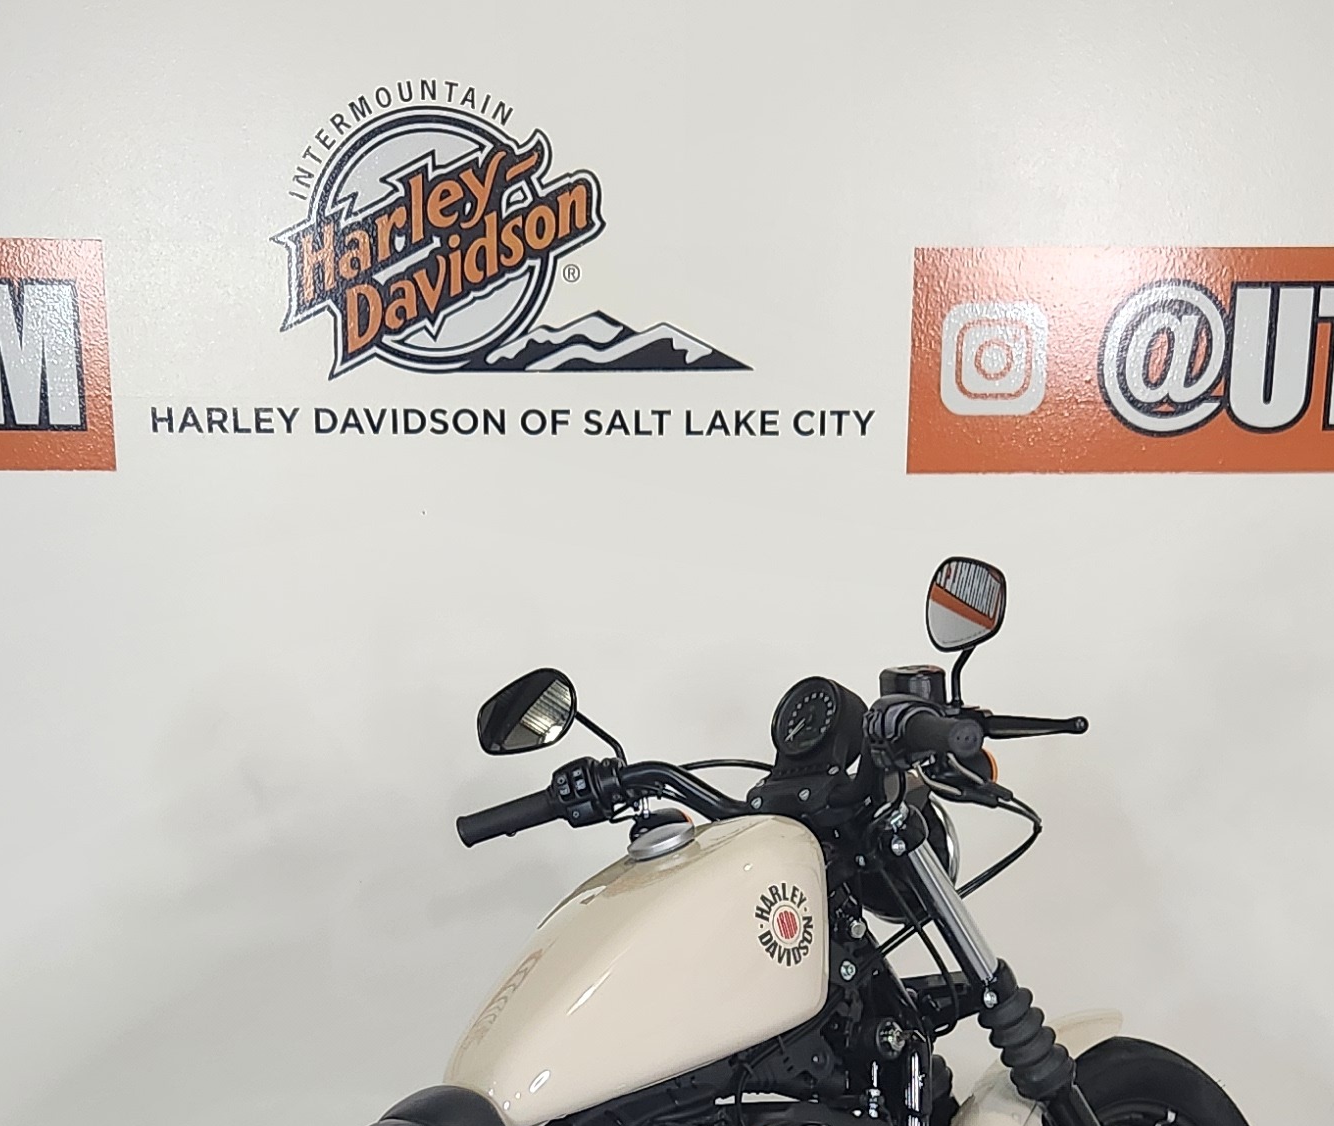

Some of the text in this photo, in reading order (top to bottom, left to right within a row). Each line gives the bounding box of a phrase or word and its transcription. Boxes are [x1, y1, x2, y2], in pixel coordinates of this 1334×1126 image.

[289, 79, 514, 200] INTERMOUNTAIN
[344, 183, 590, 355] Davidson
[151, 406, 876, 437] HARLEY DAVIDSON OF SALT LAKE CITY
[755, 882, 807, 922] HARLEY
[758, 915, 814, 967] DAVIDSON
